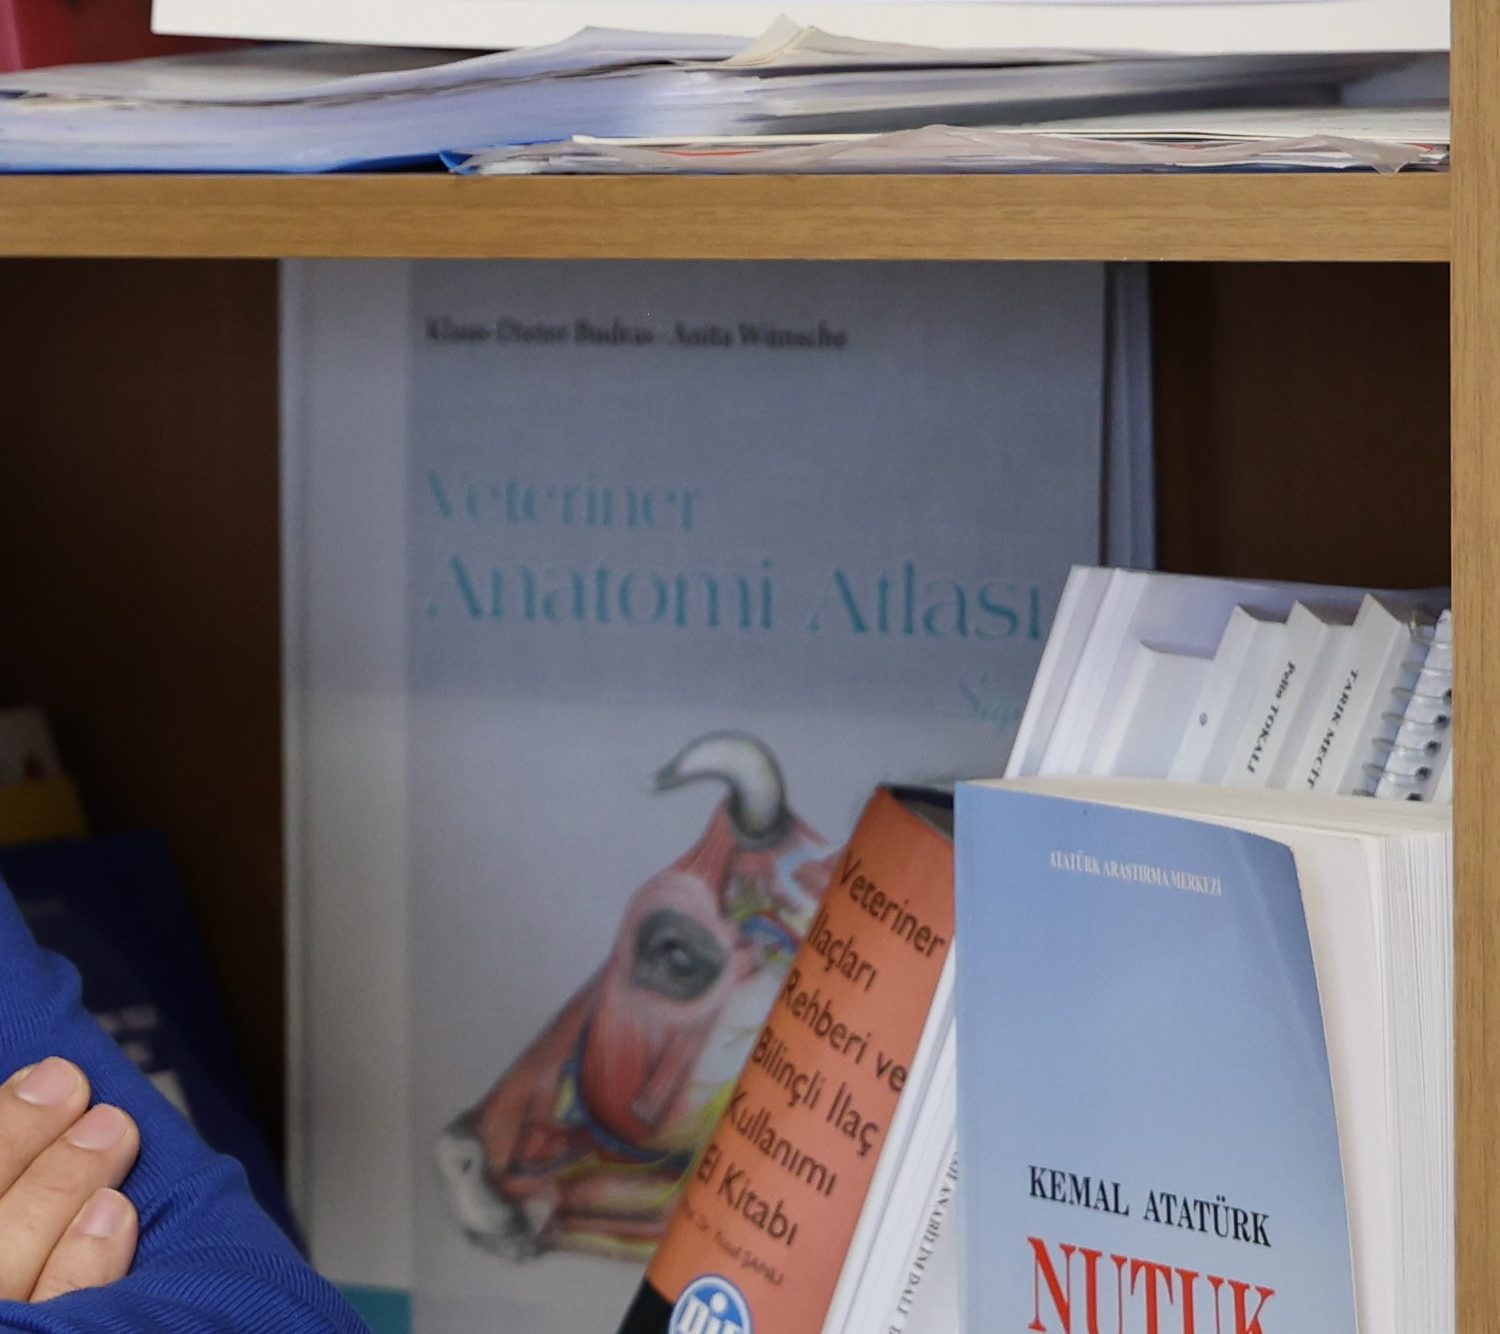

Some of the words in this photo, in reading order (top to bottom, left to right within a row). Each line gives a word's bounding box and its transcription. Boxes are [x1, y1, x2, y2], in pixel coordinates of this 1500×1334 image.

[425, 471, 700, 532] Veteriner
[425, 555, 775, 630] Anatomi
[805, 559, 1045, 642] Atlası
[1330, 668, 1360, 727] TARIK
[838, 851, 947, 958] Veteriner
[1049, 848, 1101, 875] ATATÜRK
[1103, 859, 1170, 888] ARAŞTIRMA
[1170, 869, 1223, 897] MERKEZİ
[750, 1025, 827, 1111] Bilinçli
[780, 969, 873, 1065] Rehberi
[875, 1050, 909, 1092] ve
[726, 1088, 839, 1197] Kullanımı
[717, 1162, 799, 1247] Kitabı
[1027, 1164, 1130, 1217] KEMAL
[1142, 1188, 1272, 1248] ATATÜRK
